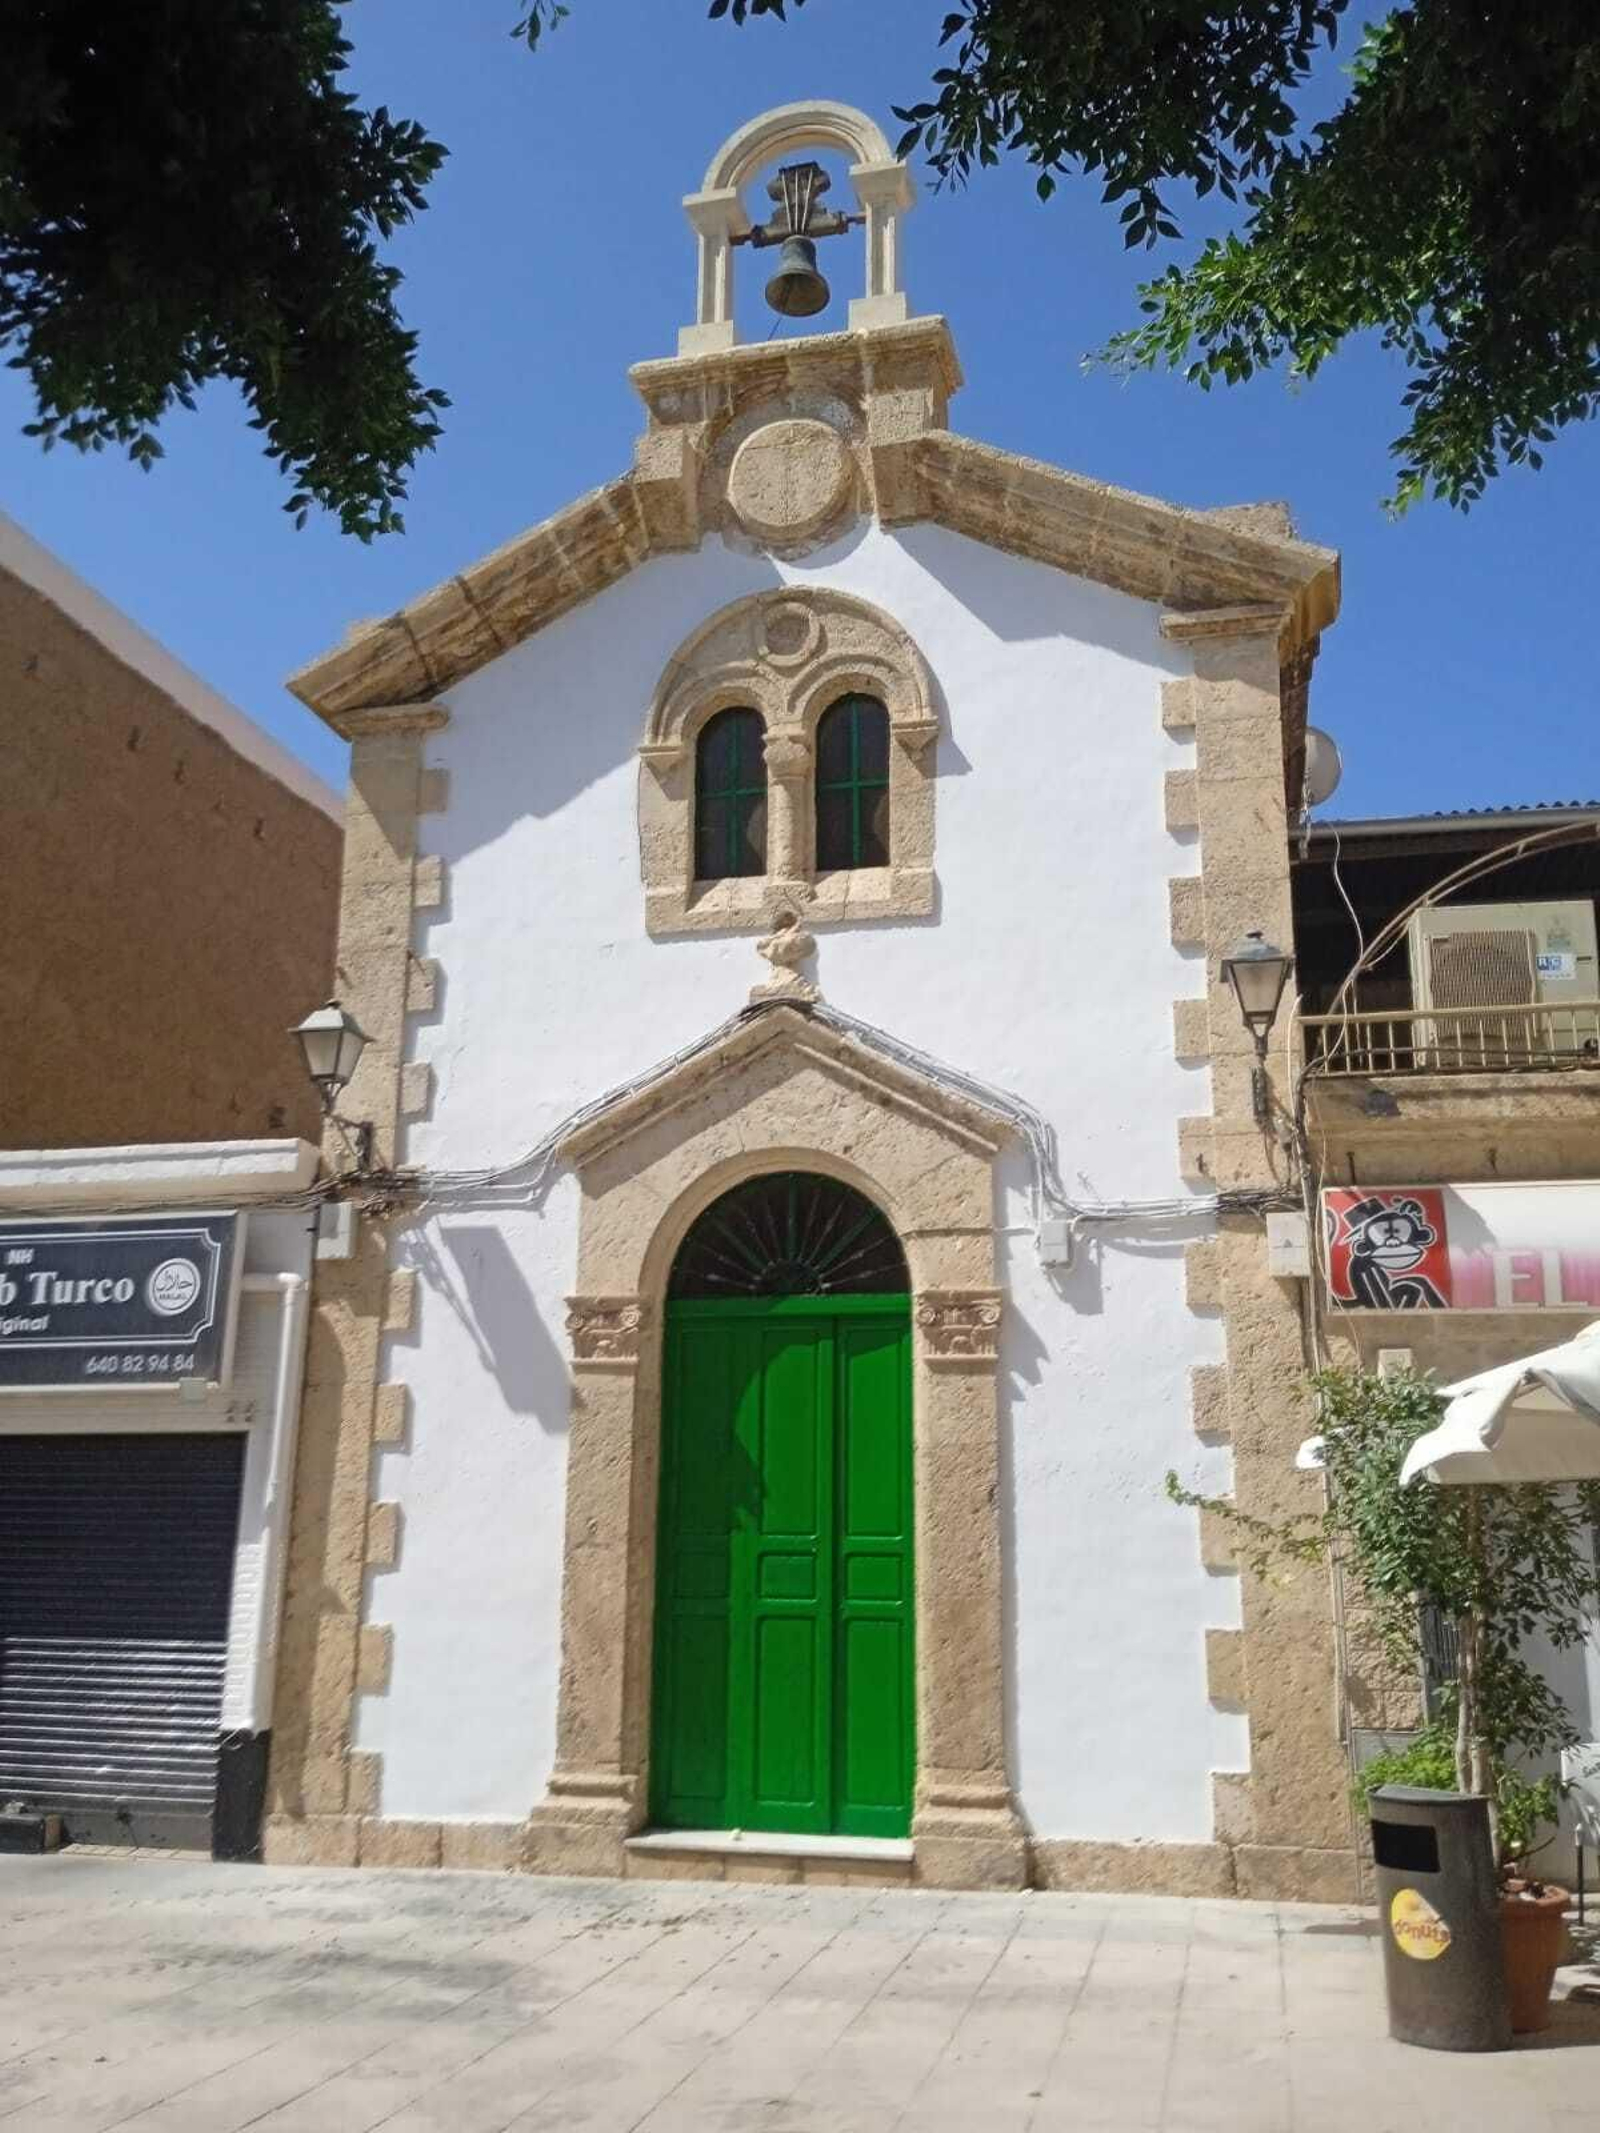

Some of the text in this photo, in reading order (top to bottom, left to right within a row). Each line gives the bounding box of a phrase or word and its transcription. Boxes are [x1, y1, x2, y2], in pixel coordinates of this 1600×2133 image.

[28, 1271, 135, 1305] Turco
[85, 1356, 117, 1374] 640
[121, 1355, 144, 1373] 82
[148, 1354, 170, 1372] 94
